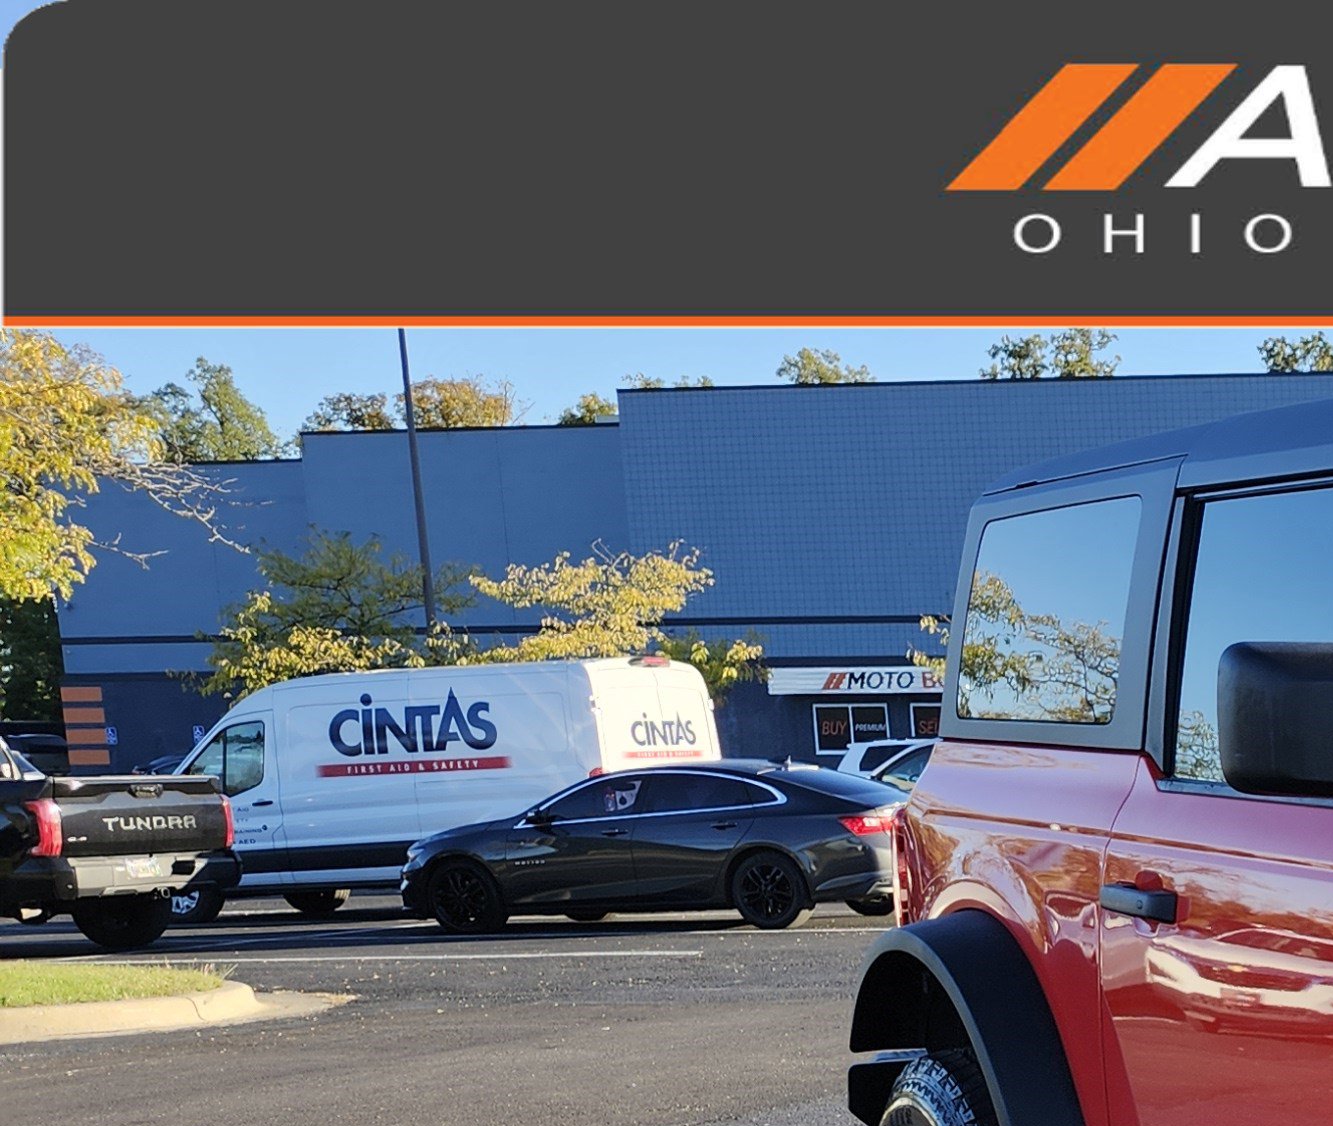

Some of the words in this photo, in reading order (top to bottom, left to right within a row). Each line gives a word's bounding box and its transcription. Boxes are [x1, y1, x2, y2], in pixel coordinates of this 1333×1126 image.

[848, 671, 915, 689] MOTO
[329, 687, 498, 757] CINTAS
[630, 710, 697, 746] CINTAS
[821, 720, 848, 736] BUY
[854, 722, 887, 732] PREMIUM
[346, 764, 382, 774] FIRST
[389, 763, 410, 772] AID
[418, 762, 425, 771] &
[432, 759, 479, 770] SAFETY
[102, 814, 197, 831] TUNDRA
